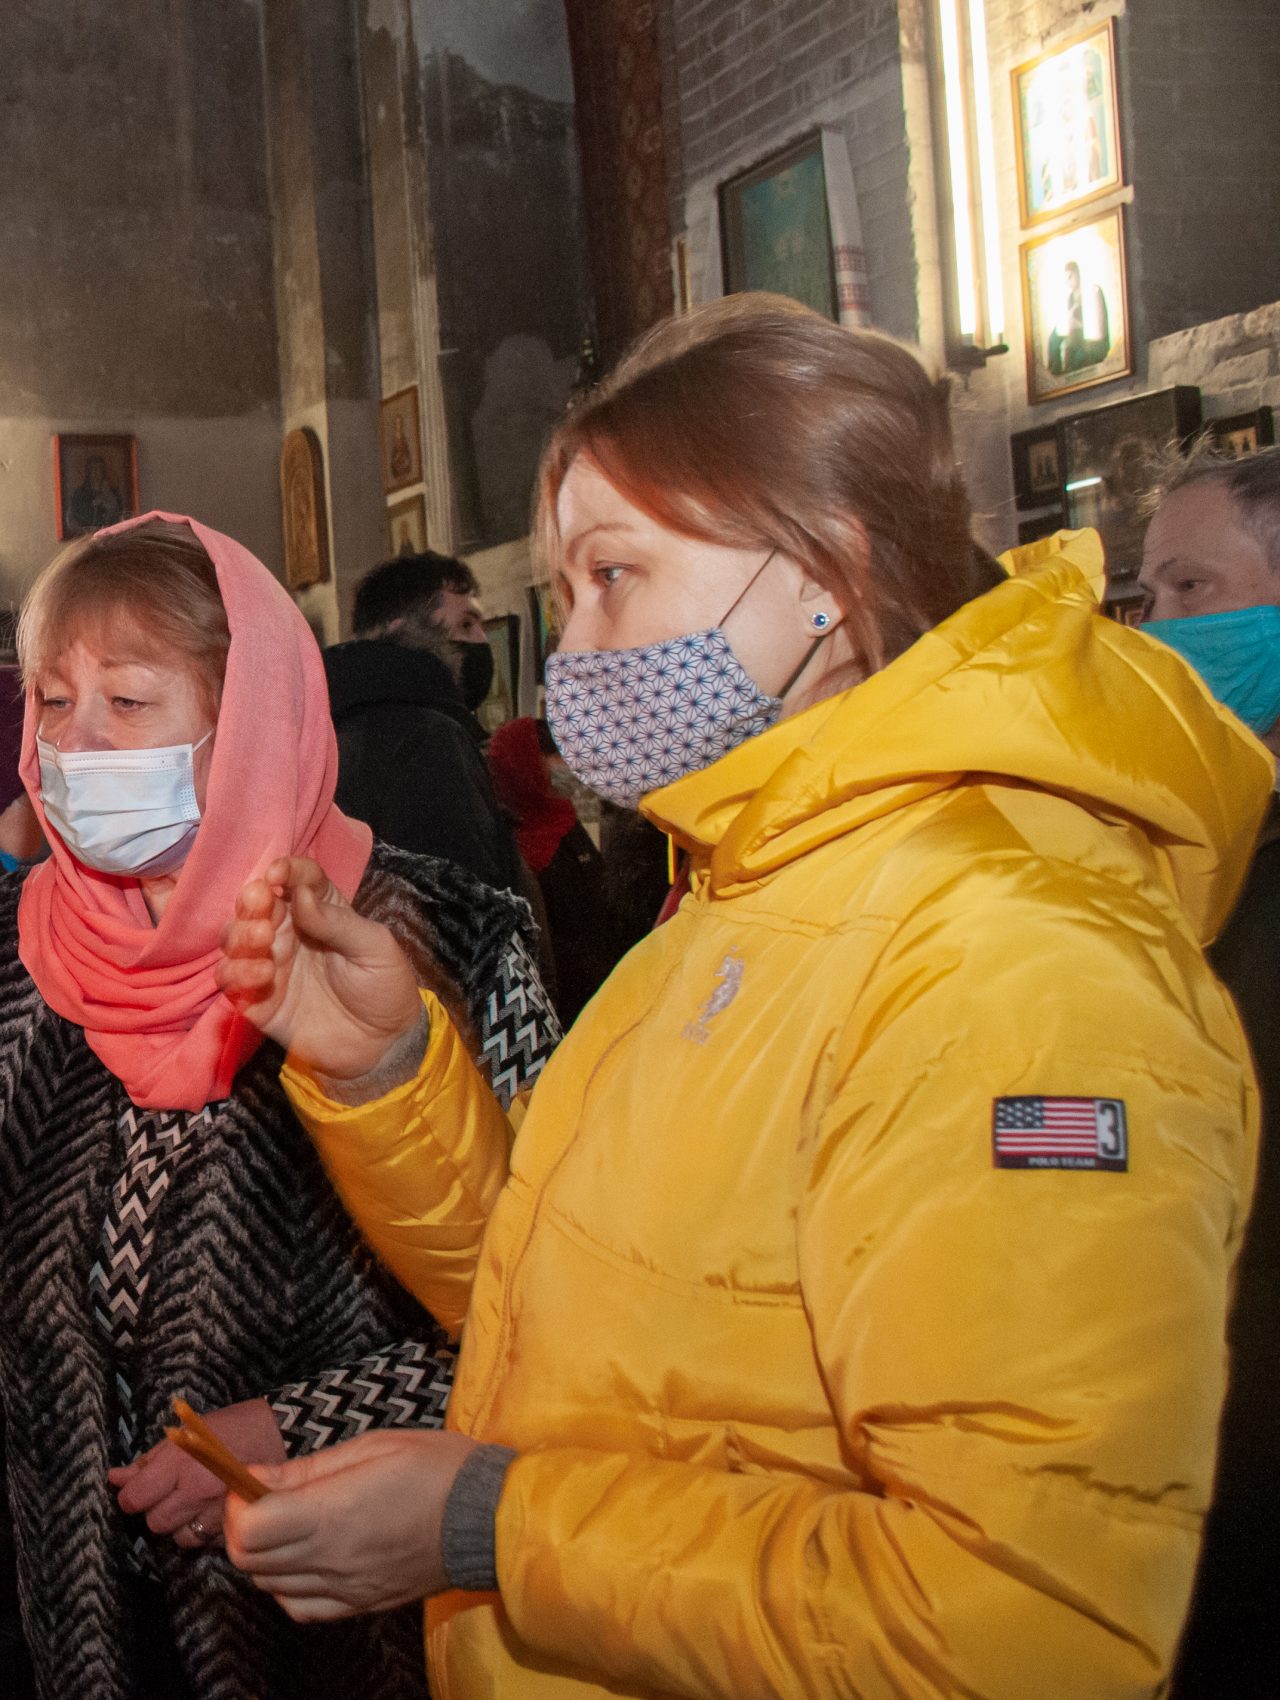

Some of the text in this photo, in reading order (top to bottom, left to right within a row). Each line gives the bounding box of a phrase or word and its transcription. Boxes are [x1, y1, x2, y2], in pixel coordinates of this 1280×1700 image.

[1099, 1102, 1121, 1155] 3
[1028, 1157, 1096, 1167] POLO TEAM
